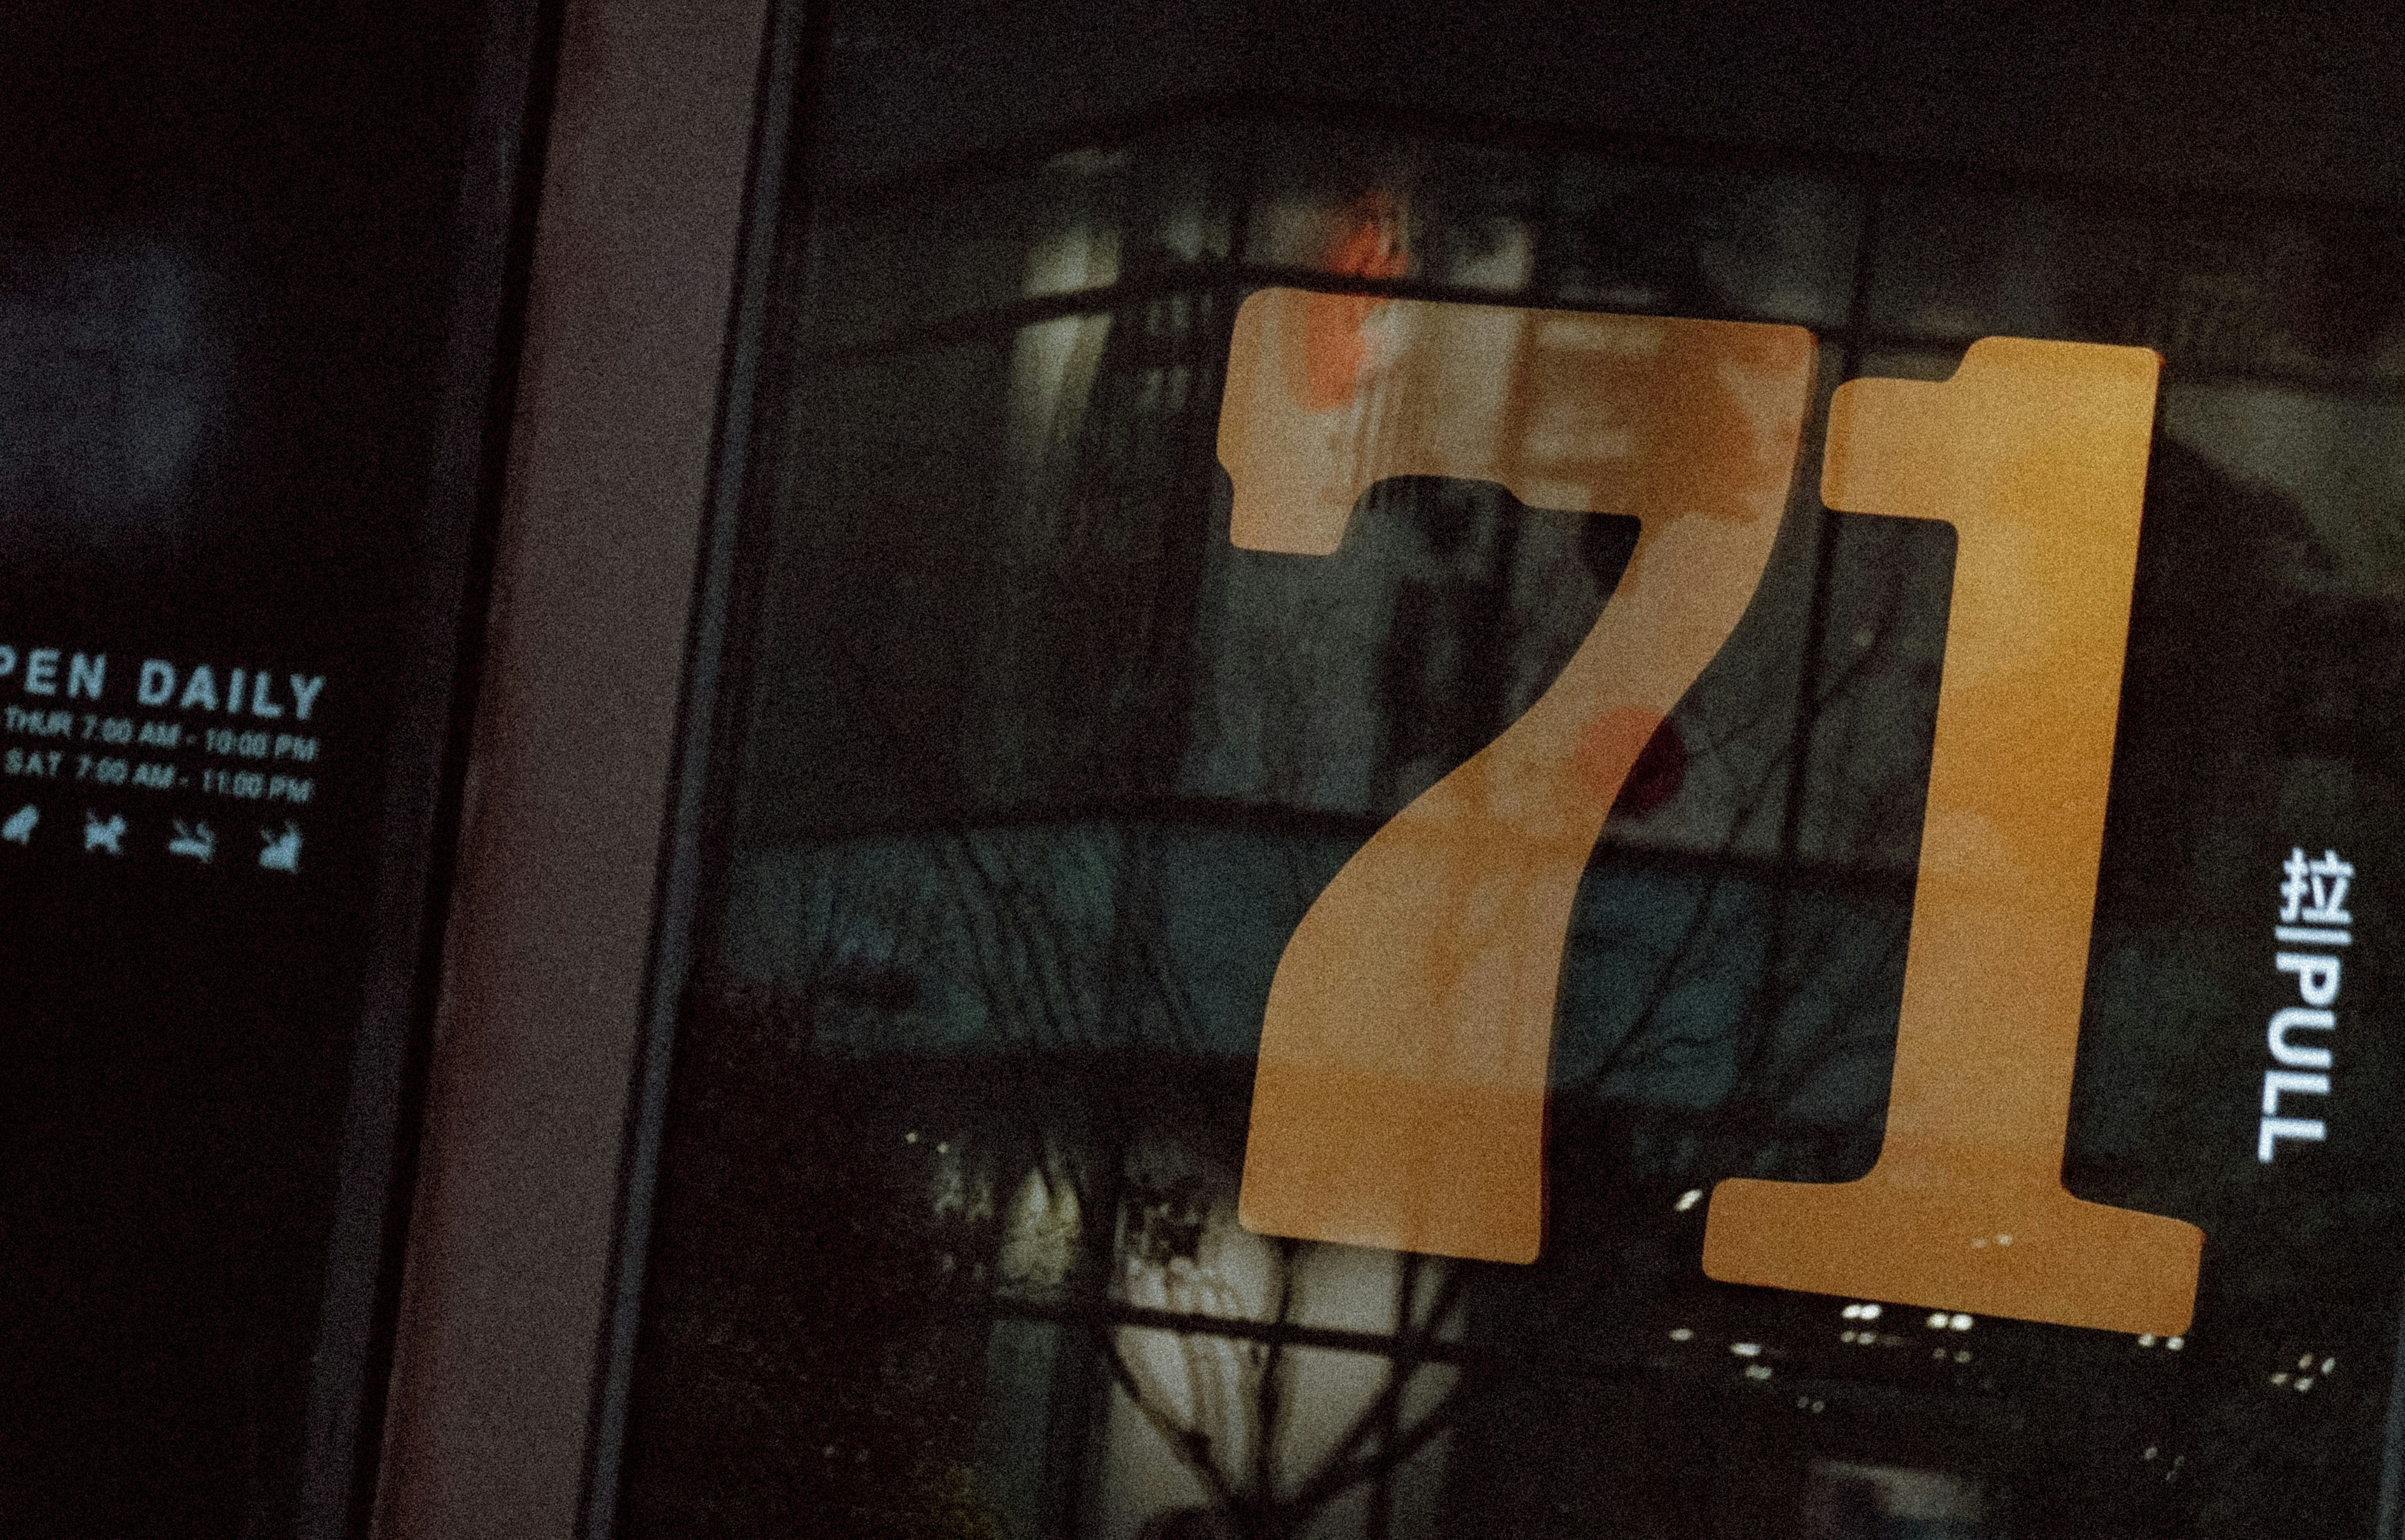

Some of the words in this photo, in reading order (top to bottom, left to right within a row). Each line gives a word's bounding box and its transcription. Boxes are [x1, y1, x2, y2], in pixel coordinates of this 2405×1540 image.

[136, 657, 326, 720] DAILY
[4, 705, 73, 739] THUR
[137, 719, 182, 749] AM
[205, 726, 270, 757] 10:00
[273, 733, 319, 763] PM
[4, 746, 65, 779] SAT
[131, 761, 177, 789] AM
[267, 773, 315, 805] PM
[1216, 286, 2206, 1337] 71
[2279, 847, 2354, 923] 拉
[2258, 952, 2341, 1163] PULL
